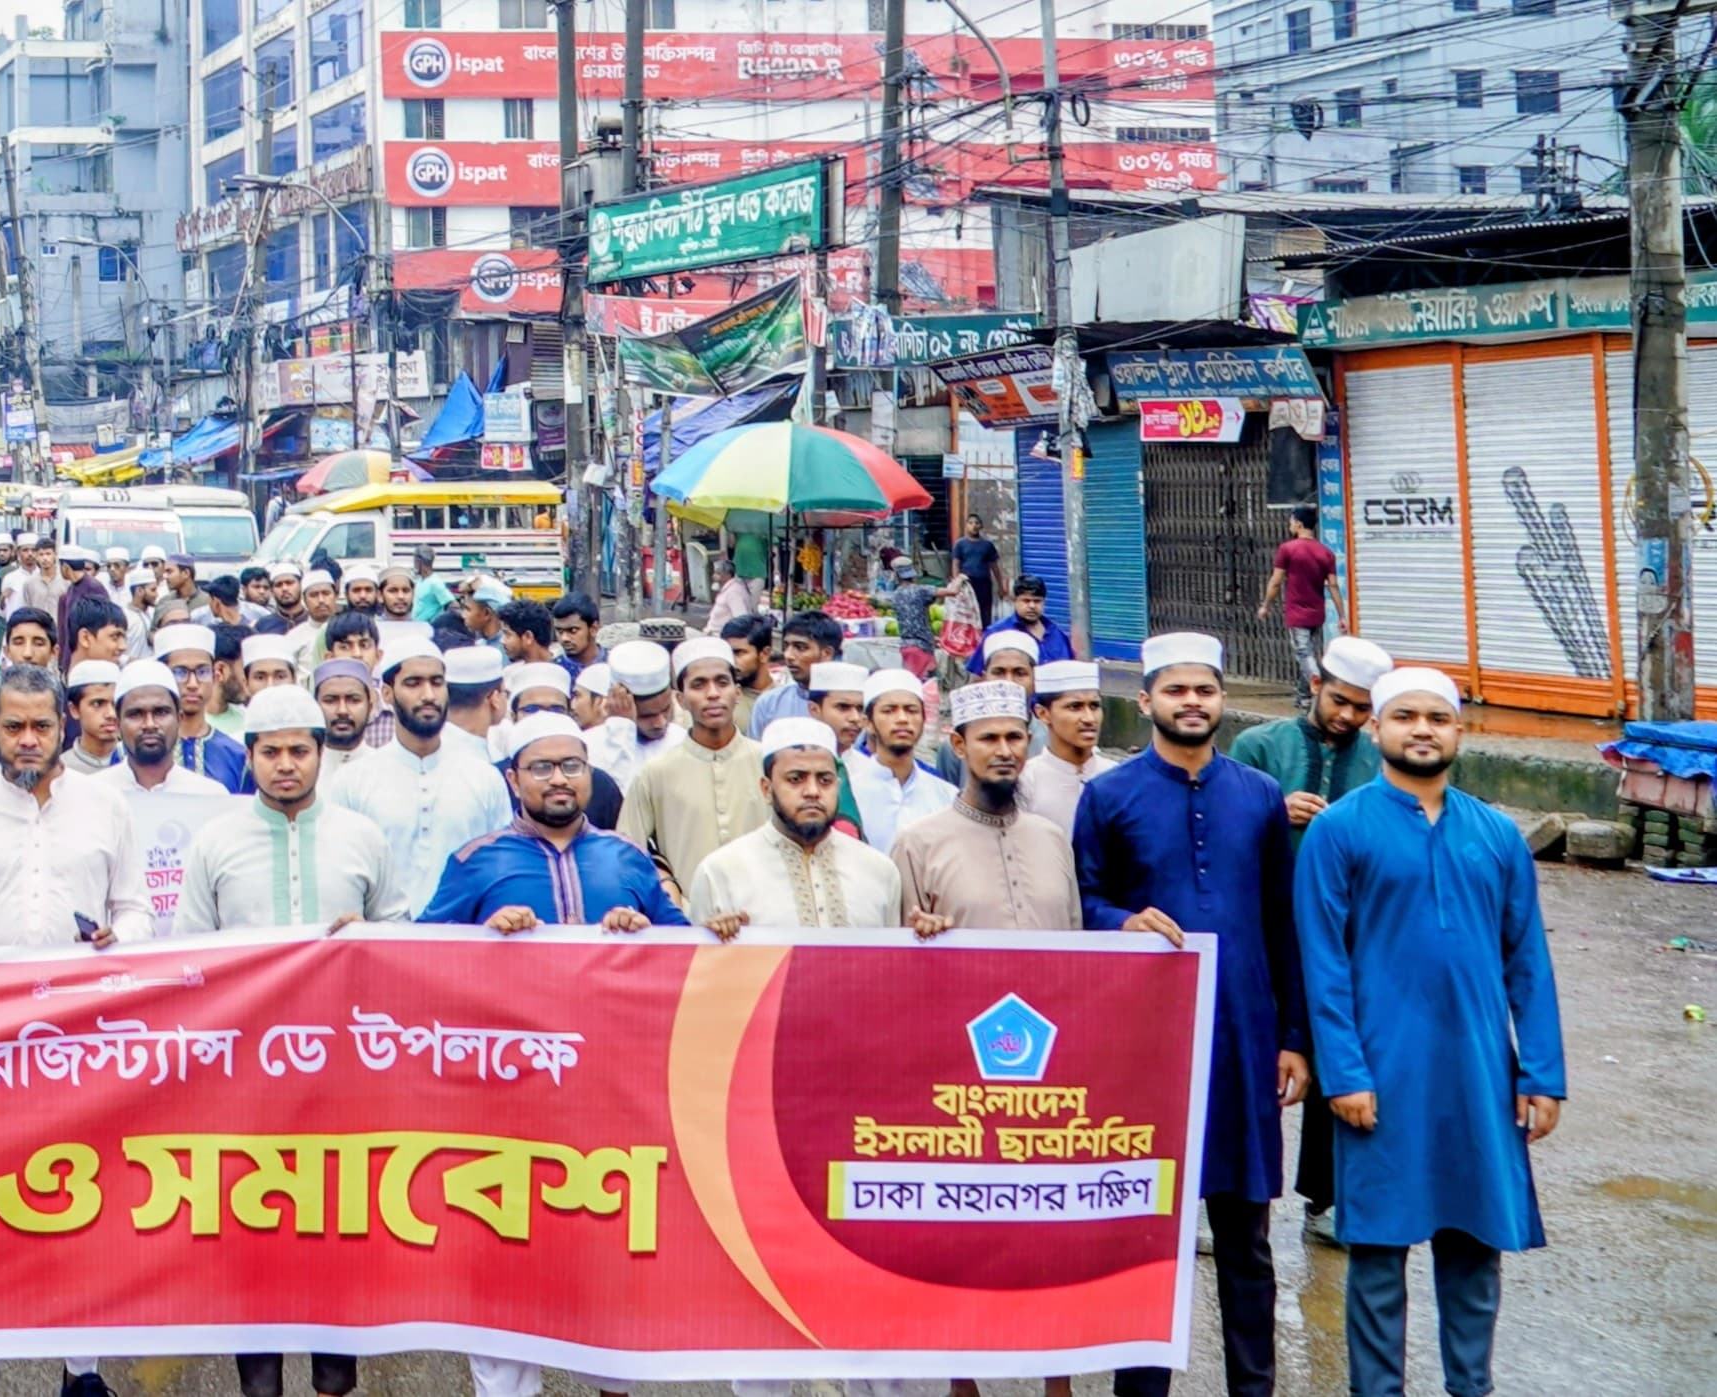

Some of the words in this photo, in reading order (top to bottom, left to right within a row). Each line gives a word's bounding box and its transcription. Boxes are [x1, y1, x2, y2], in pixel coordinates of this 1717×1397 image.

[411, 55, 444, 74] GPH
[455, 53, 505, 76] ispat
[414, 165, 447, 183] GPH
[458, 162, 508, 184] ispat
[762, 175, 816, 217] কলেজ
[1364, 496, 1455, 526] CSRM
[257, 1023, 336, 1077] ডে
[347, 1005, 585, 1088] উপলক্ষে
[932, 1083, 1088, 1118] বাংলাদেশ
[853, 1115, 984, 1159] ইসলামী
[996, 1116, 1155, 1163] ছাত্রশিবির
[124, 1128, 668, 1254] সমাবেশ
[852, 1180, 924, 1210] ঢাকা
[935, 1180, 1067, 1213] মহানগর
[1077, 1169, 1153, 1208] দক্ষিণ
